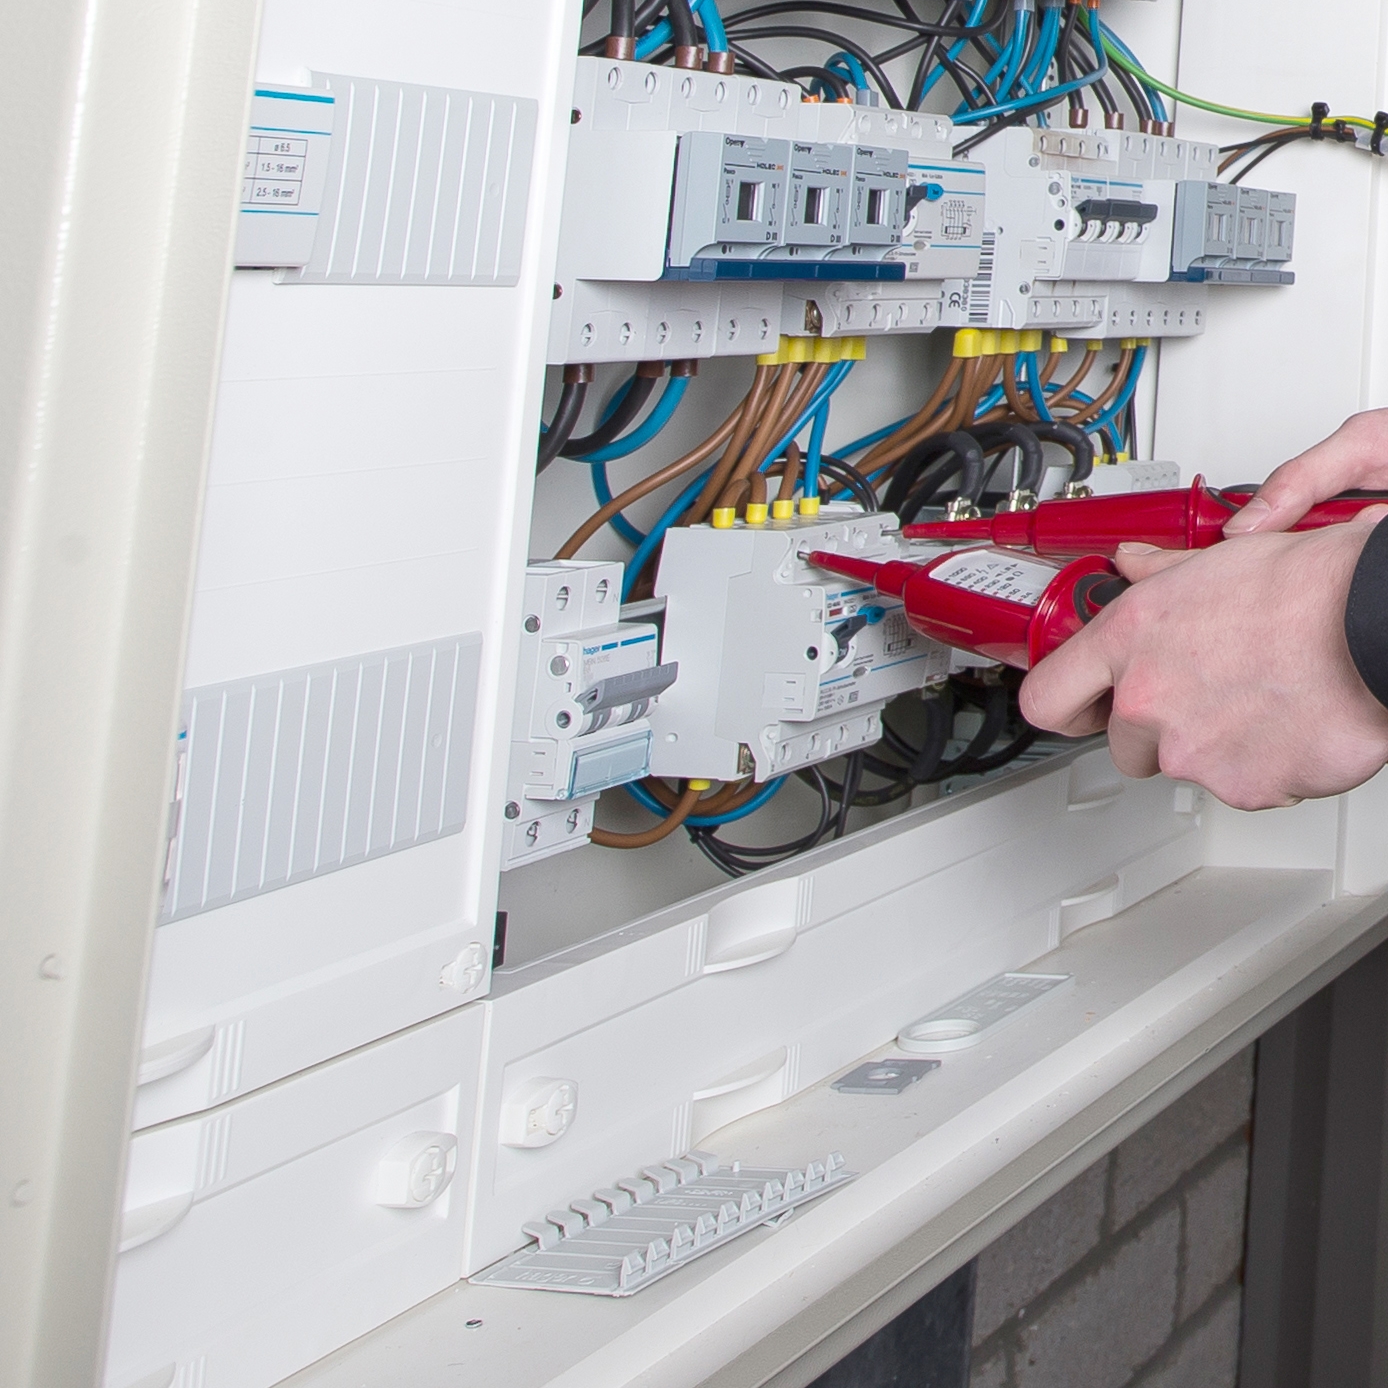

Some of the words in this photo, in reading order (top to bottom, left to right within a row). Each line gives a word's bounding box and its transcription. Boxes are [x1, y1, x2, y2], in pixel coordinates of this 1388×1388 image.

[261, 162, 271, 172] 1.5
[756, 162, 776, 170] HOLEC
[822, 168, 840, 176] HOLEC
[256, 187, 267, 197] 2.5
[948, 292, 961, 308] CE
